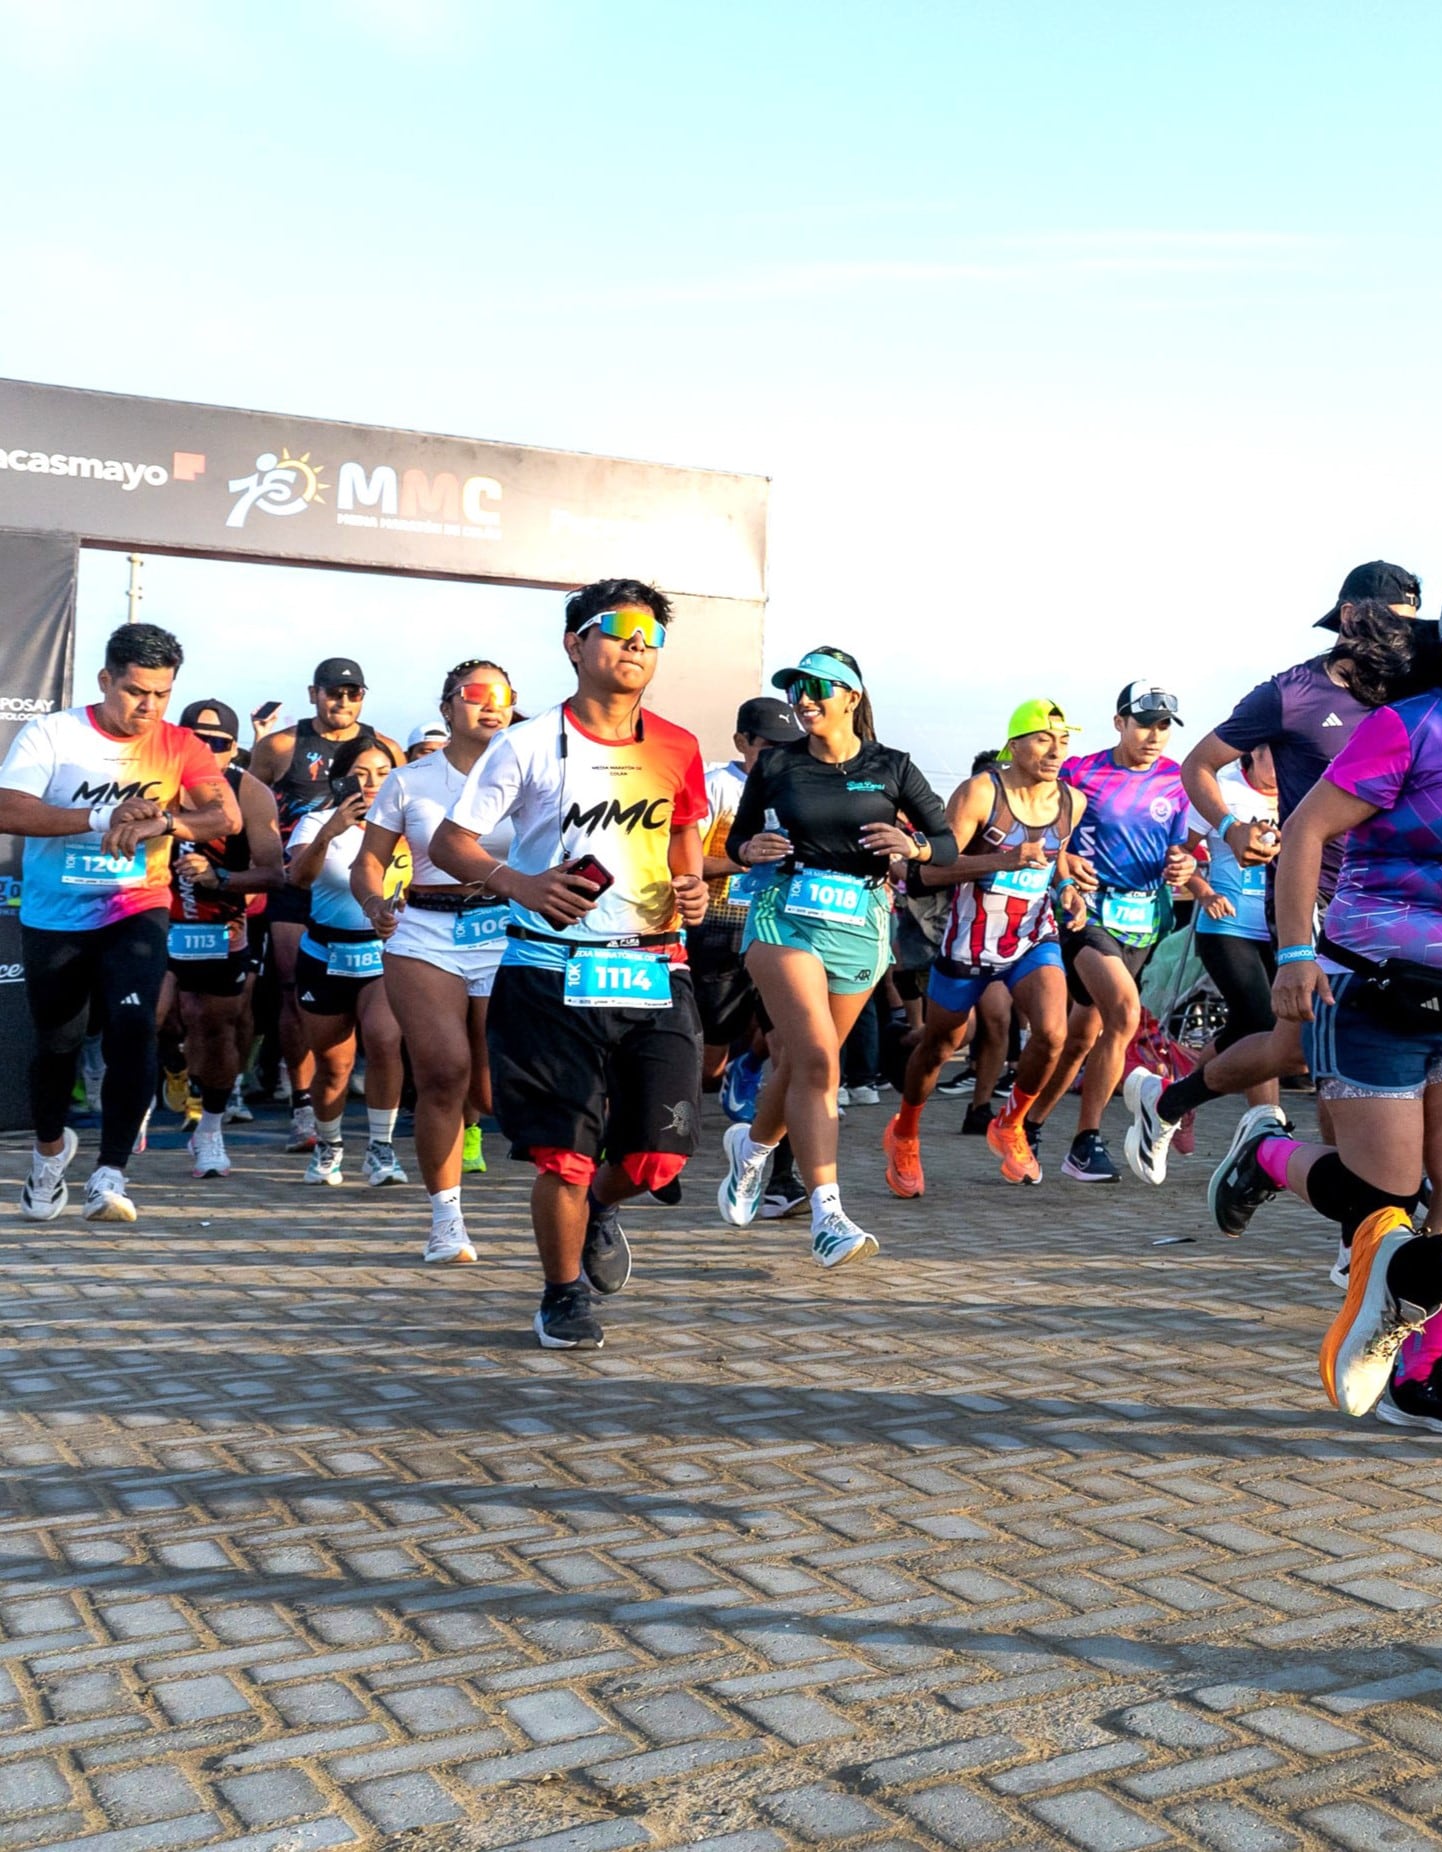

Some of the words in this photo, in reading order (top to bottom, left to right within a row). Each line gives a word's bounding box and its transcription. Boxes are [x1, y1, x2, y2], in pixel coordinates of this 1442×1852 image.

[337, 462, 502, 526] MMC
[72, 781, 162, 805] MMC
[562, 799, 669, 837] MMC
[808, 883, 858, 910] 1018
[184, 935, 216, 949] 1113
[567, 963, 582, 986] 10K
[595, 966, 653, 991] 1114
